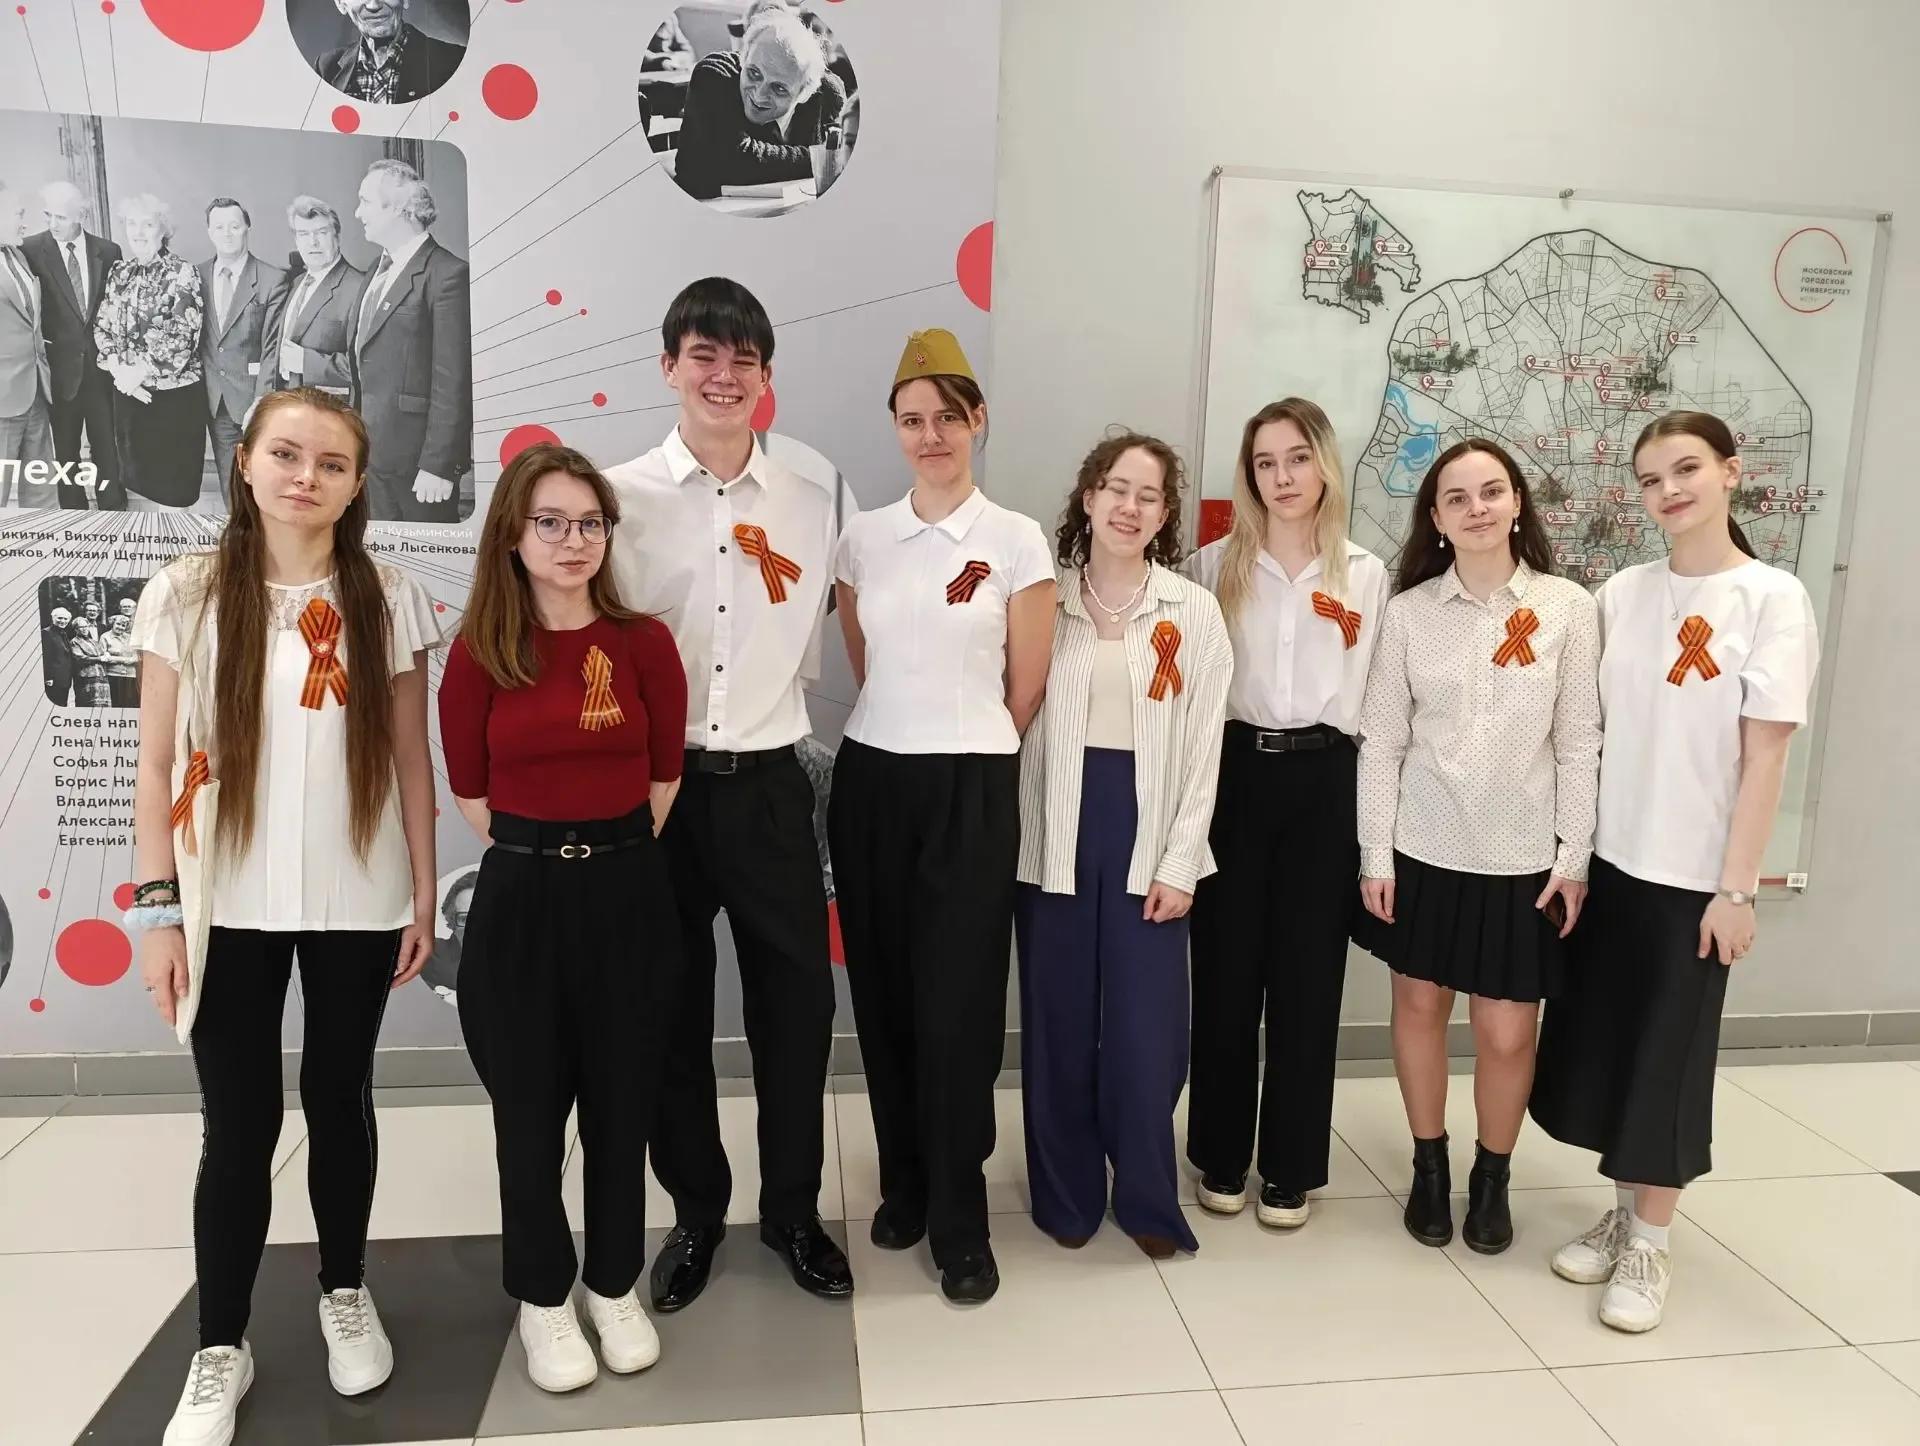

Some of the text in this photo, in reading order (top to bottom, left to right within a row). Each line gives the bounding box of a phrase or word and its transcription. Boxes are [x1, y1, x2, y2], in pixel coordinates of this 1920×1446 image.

[1802, 267, 1853, 276] МОСКОВСКИЙ
[1801, 277, 1845, 285] ГОРОДСКОЙ
[1800, 287, 1850, 295] УНИВЕРСИТЕТ
[65, 531, 118, 544] Виктор
[123, 533, 191, 545] Шаталов,
[387, 525, 473, 538] Кузьминский
[53, 548, 108, 559] Михаил
[400, 542, 476, 554] Лысенкова
[50, 715, 138, 728] Слева нап
[51, 736, 93, 748] Лена
[53, 755, 108, 770] Софья
[55, 775, 136, 789] Борис Ни
[59, 835, 127, 846] Евгений
